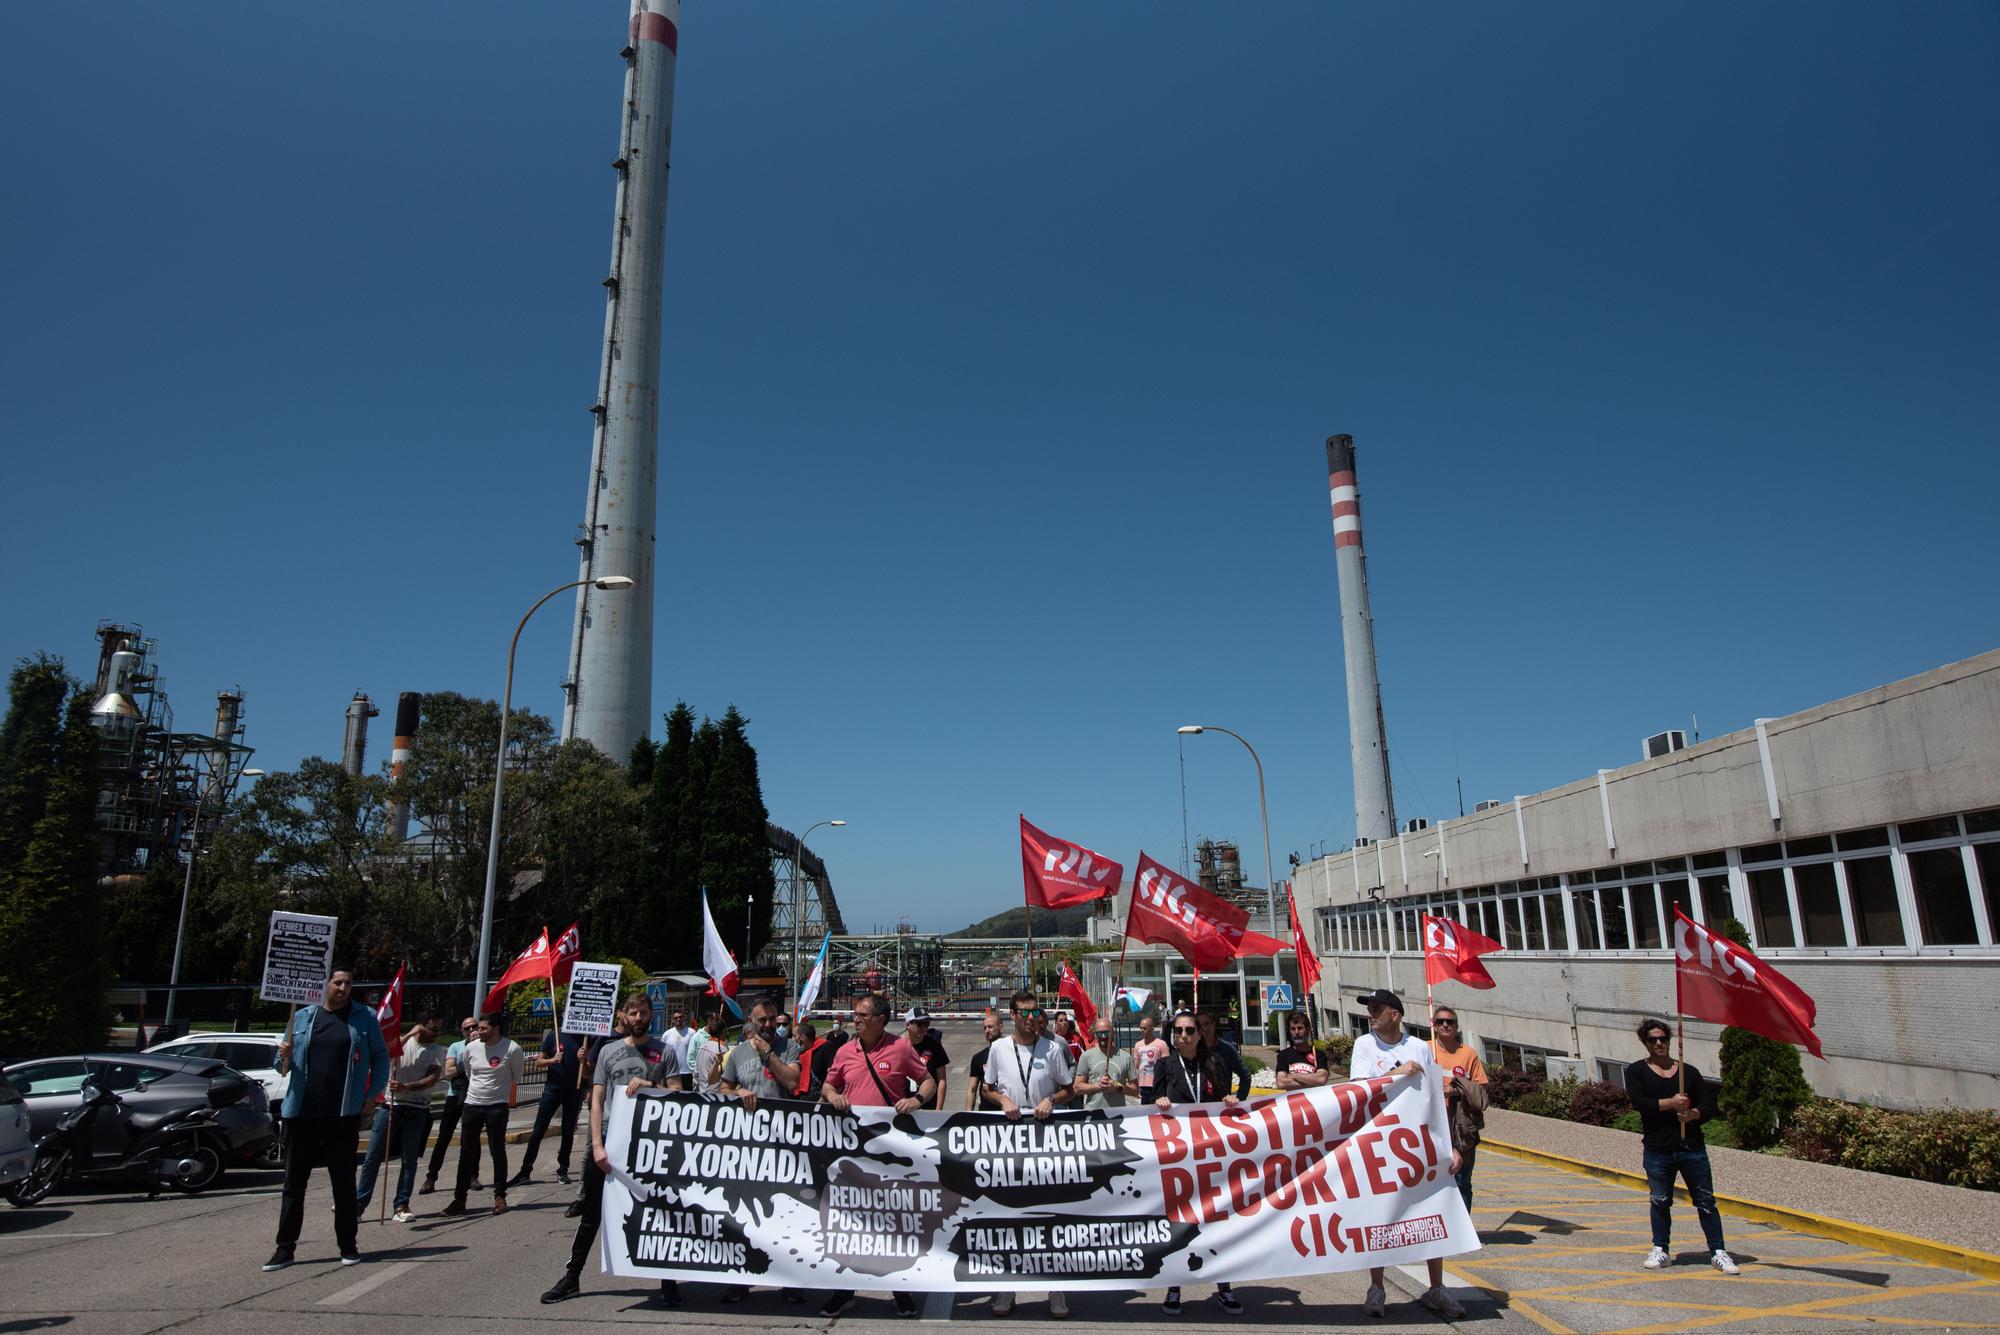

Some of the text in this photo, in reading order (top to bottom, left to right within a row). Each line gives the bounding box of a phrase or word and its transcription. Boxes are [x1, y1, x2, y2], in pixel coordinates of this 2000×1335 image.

[1140, 867, 1197, 924] CIG
[304, 924, 328, 934] NEGRO
[1674, 918, 1758, 985] CIG
[640, 1100, 859, 1150] PROLONGACIÓNS
[949, 1116, 1116, 1154] CONXELACIÓN
[1148, 1077, 1400, 1165] BASTA DE
[635, 1138, 814, 1184] DE XORNADA
[974, 1155, 1093, 1188] SALARIAL
[1160, 1124, 1438, 1224] RECORTES!
[830, 1182, 942, 1211] REDUCIÓN DE
[640, 1208, 725, 1238] FALTA DE
[827, 1209, 924, 1234] POSTOS DE
[966, 1220, 1172, 1251] FALTA DE COBERTURAS
[1290, 1212, 1365, 1258] CIG
[1405, 1217, 1442, 1232] SINDICAL
[636, 1234, 746, 1266] INVERSIÓNS
[826, 1232, 919, 1257] TRABALLO
[1370, 1227, 1444, 1250] REPSOL PETROLEO
[968, 1249, 1145, 1274] DAS PATERNIDADES
